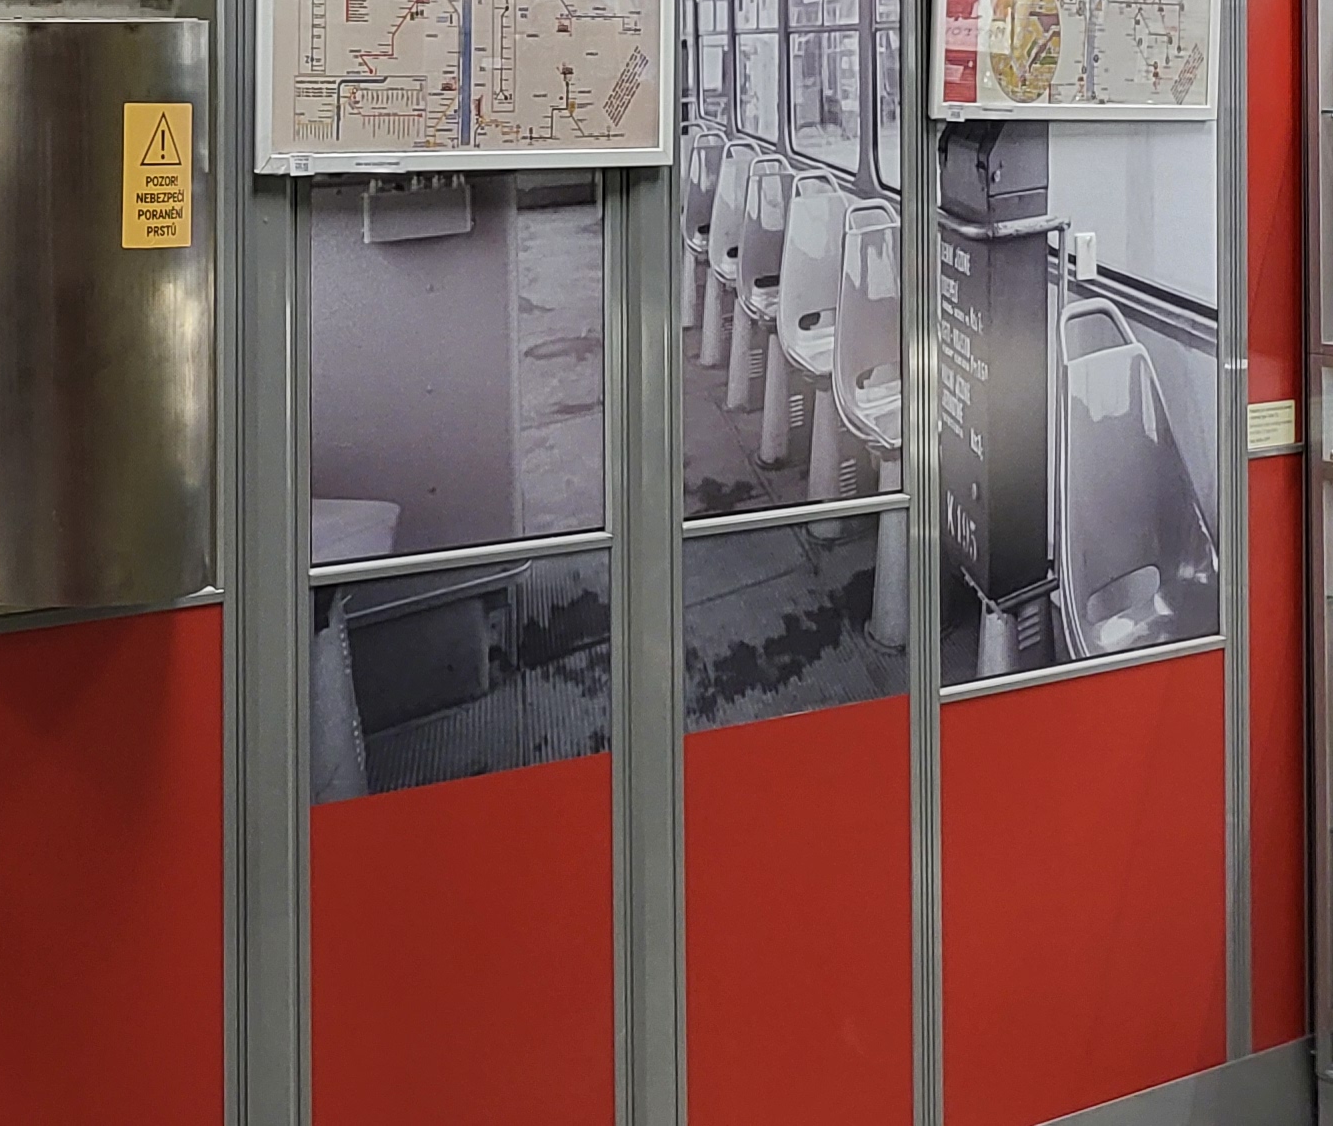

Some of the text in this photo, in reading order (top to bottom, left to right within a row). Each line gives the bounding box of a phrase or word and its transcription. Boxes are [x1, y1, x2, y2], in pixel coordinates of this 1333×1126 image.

[146, 176, 179, 187] POZOR!
[136, 189, 184, 203] NEBEZPEČÍ
[138, 206, 183, 220] PORANĚNÍ
[147, 222, 176, 237] PRSTŮ
